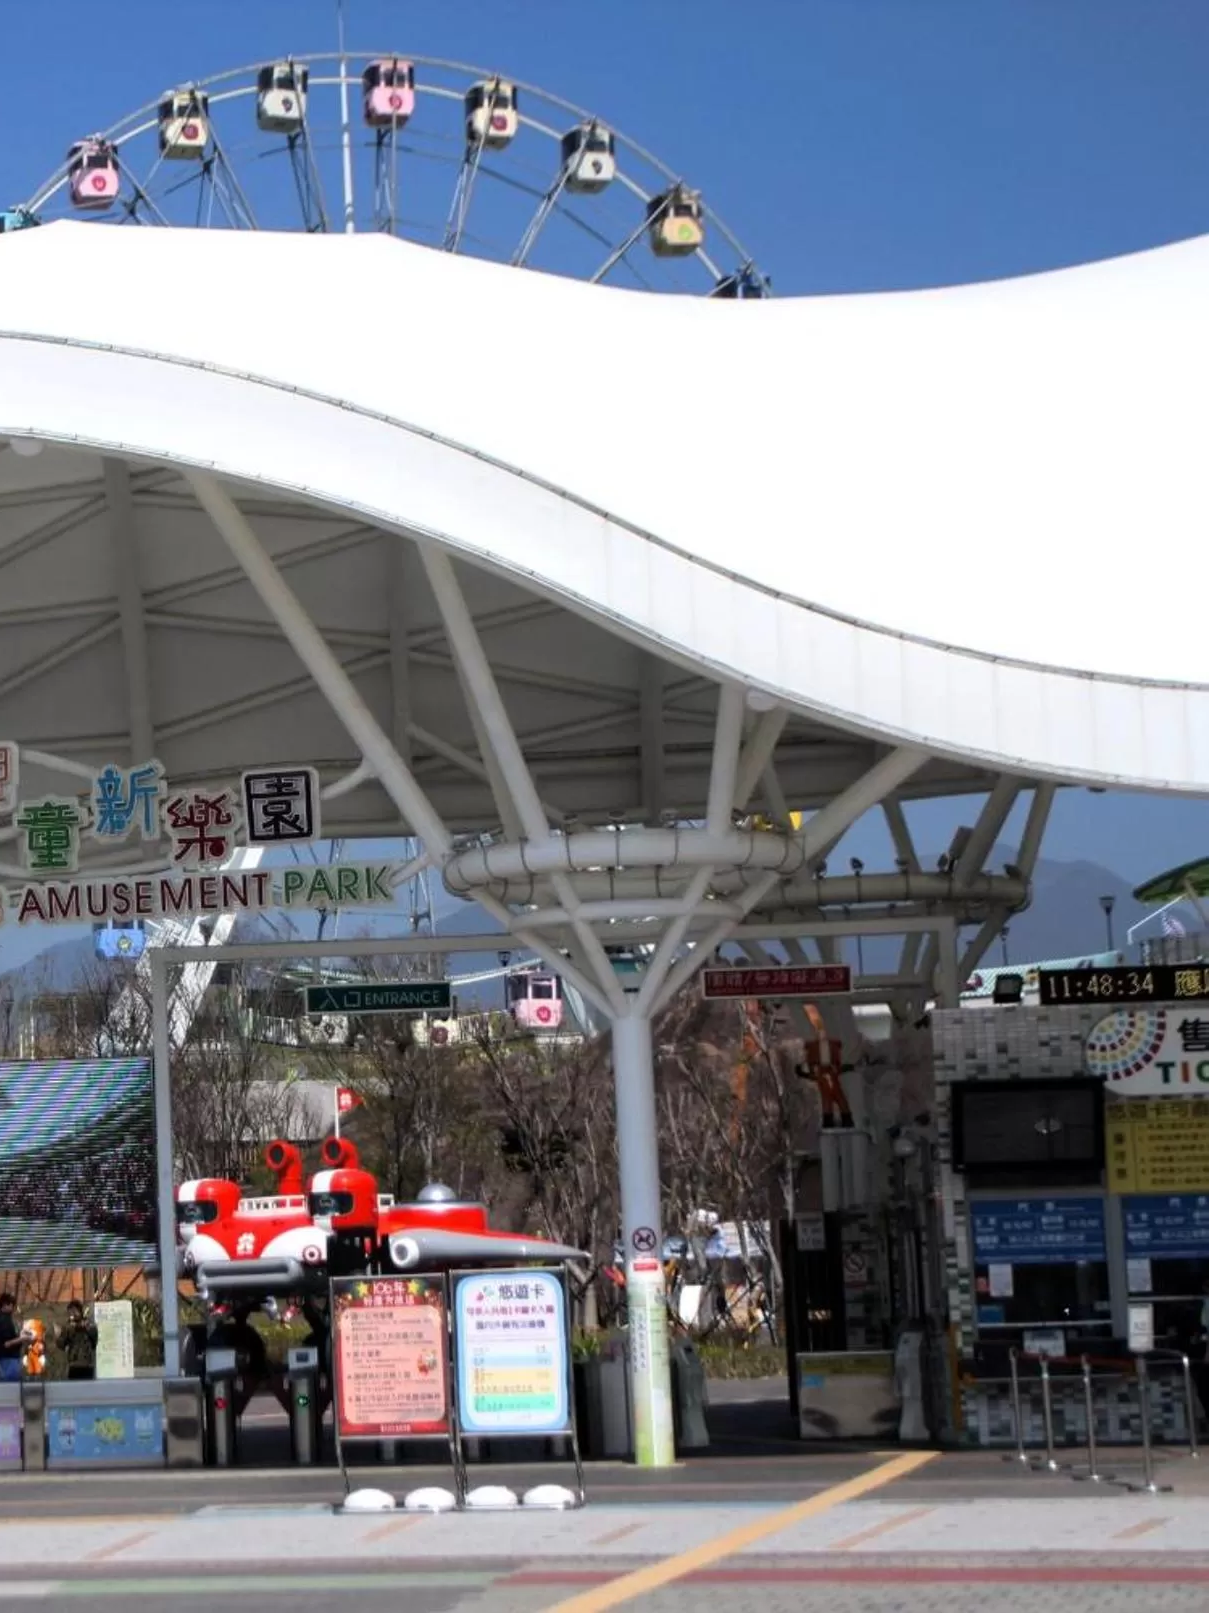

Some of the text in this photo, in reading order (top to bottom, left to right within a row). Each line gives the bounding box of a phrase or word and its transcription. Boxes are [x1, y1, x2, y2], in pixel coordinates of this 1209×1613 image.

[18, 871, 270, 922] AMUSEMENT
[284, 864, 392, 904] PARK
[319, 987, 441, 1010] 入口 ENTRANCE
[1048, 971, 1155, 999] 11:48:34
